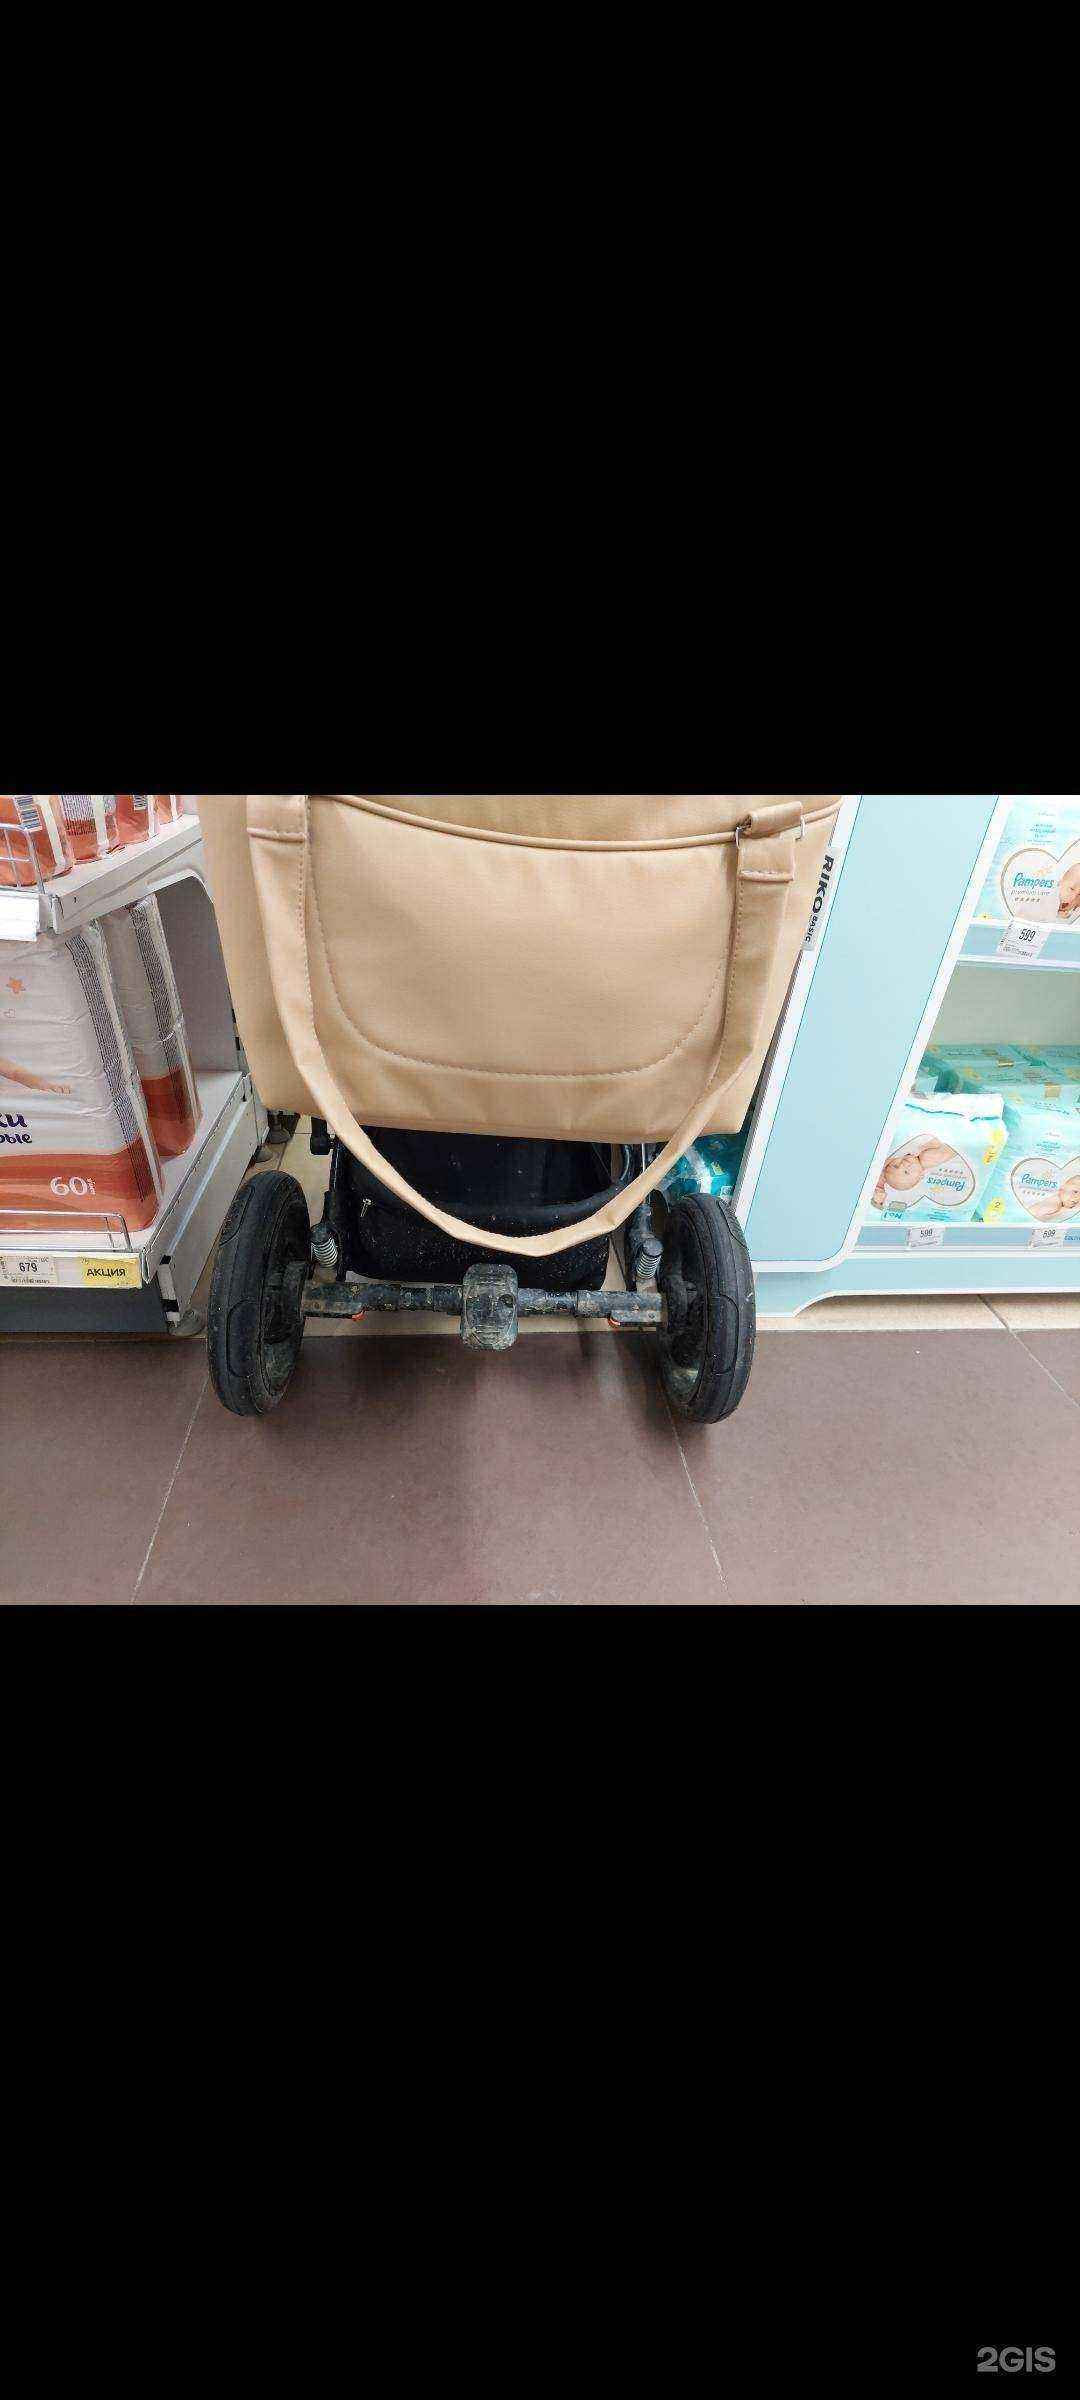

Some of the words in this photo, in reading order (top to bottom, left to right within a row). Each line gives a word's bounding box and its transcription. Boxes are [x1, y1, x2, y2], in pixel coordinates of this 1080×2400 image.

[812, 854, 835, 914] RIKO
[1012, 872, 1056, 889] Pampers
[805, 914, 819, 942] BASIC
[1018, 928, 1037, 942] 599
[50, 1176, 88, 1196] 60
[926, 1176, 966, 1192] Pampers
[1020, 1173, 1058, 1189] Pampers
[19, 1262, 38, 1273] 679
[86, 1268, 126, 1278] АКЦИЯ
